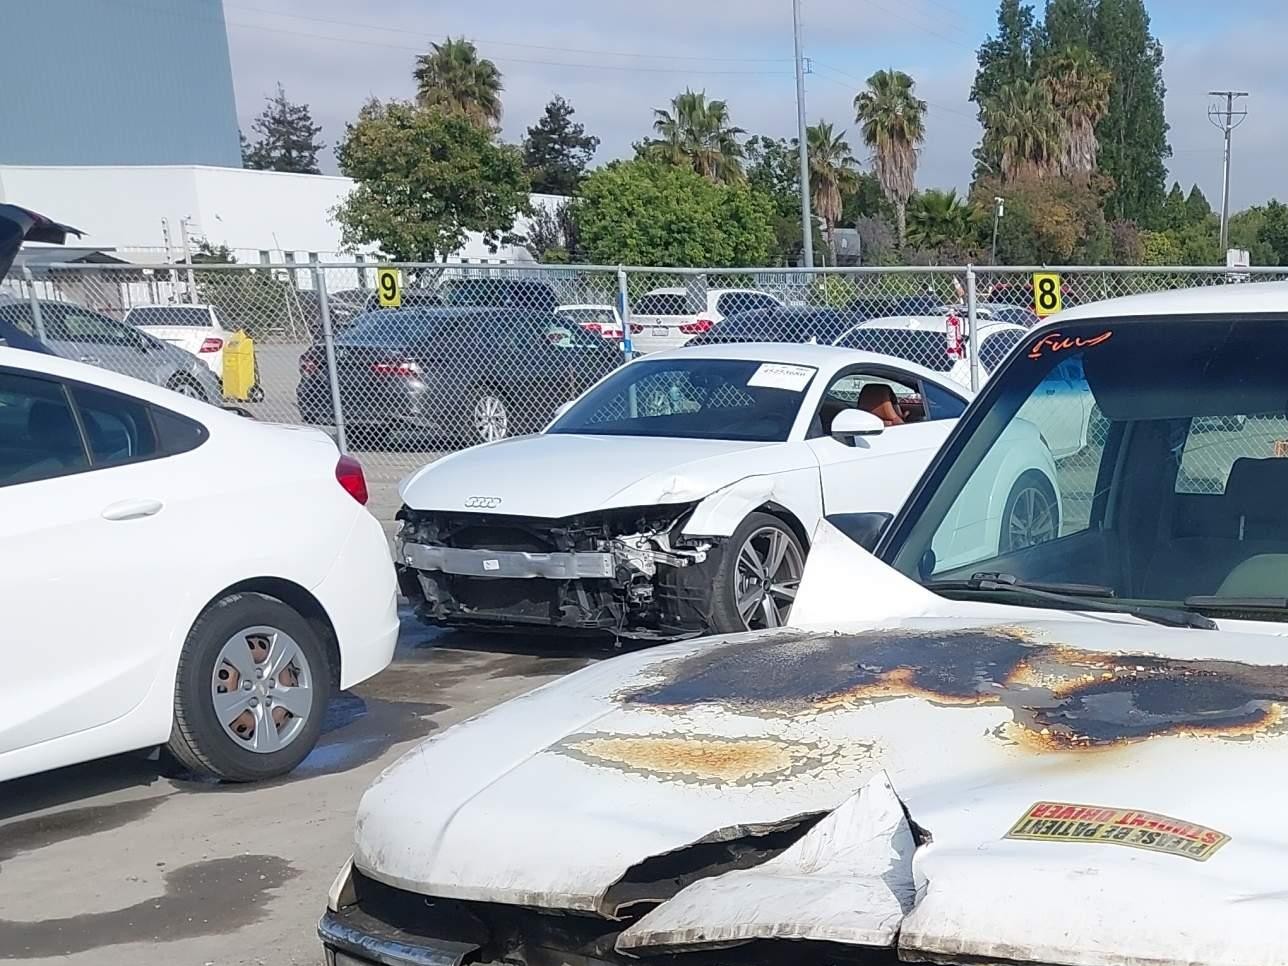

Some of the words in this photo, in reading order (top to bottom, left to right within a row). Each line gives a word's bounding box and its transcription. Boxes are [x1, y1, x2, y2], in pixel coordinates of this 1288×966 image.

[381, 272, 397, 301] 9
[1038, 278, 1058, 310] 8
[1029, 803, 1116, 823] DRIVER
[1014, 818, 1099, 839] PATIENT
[1100, 825, 1133, 840] BE
[1131, 829, 1209, 855] PLEASE
